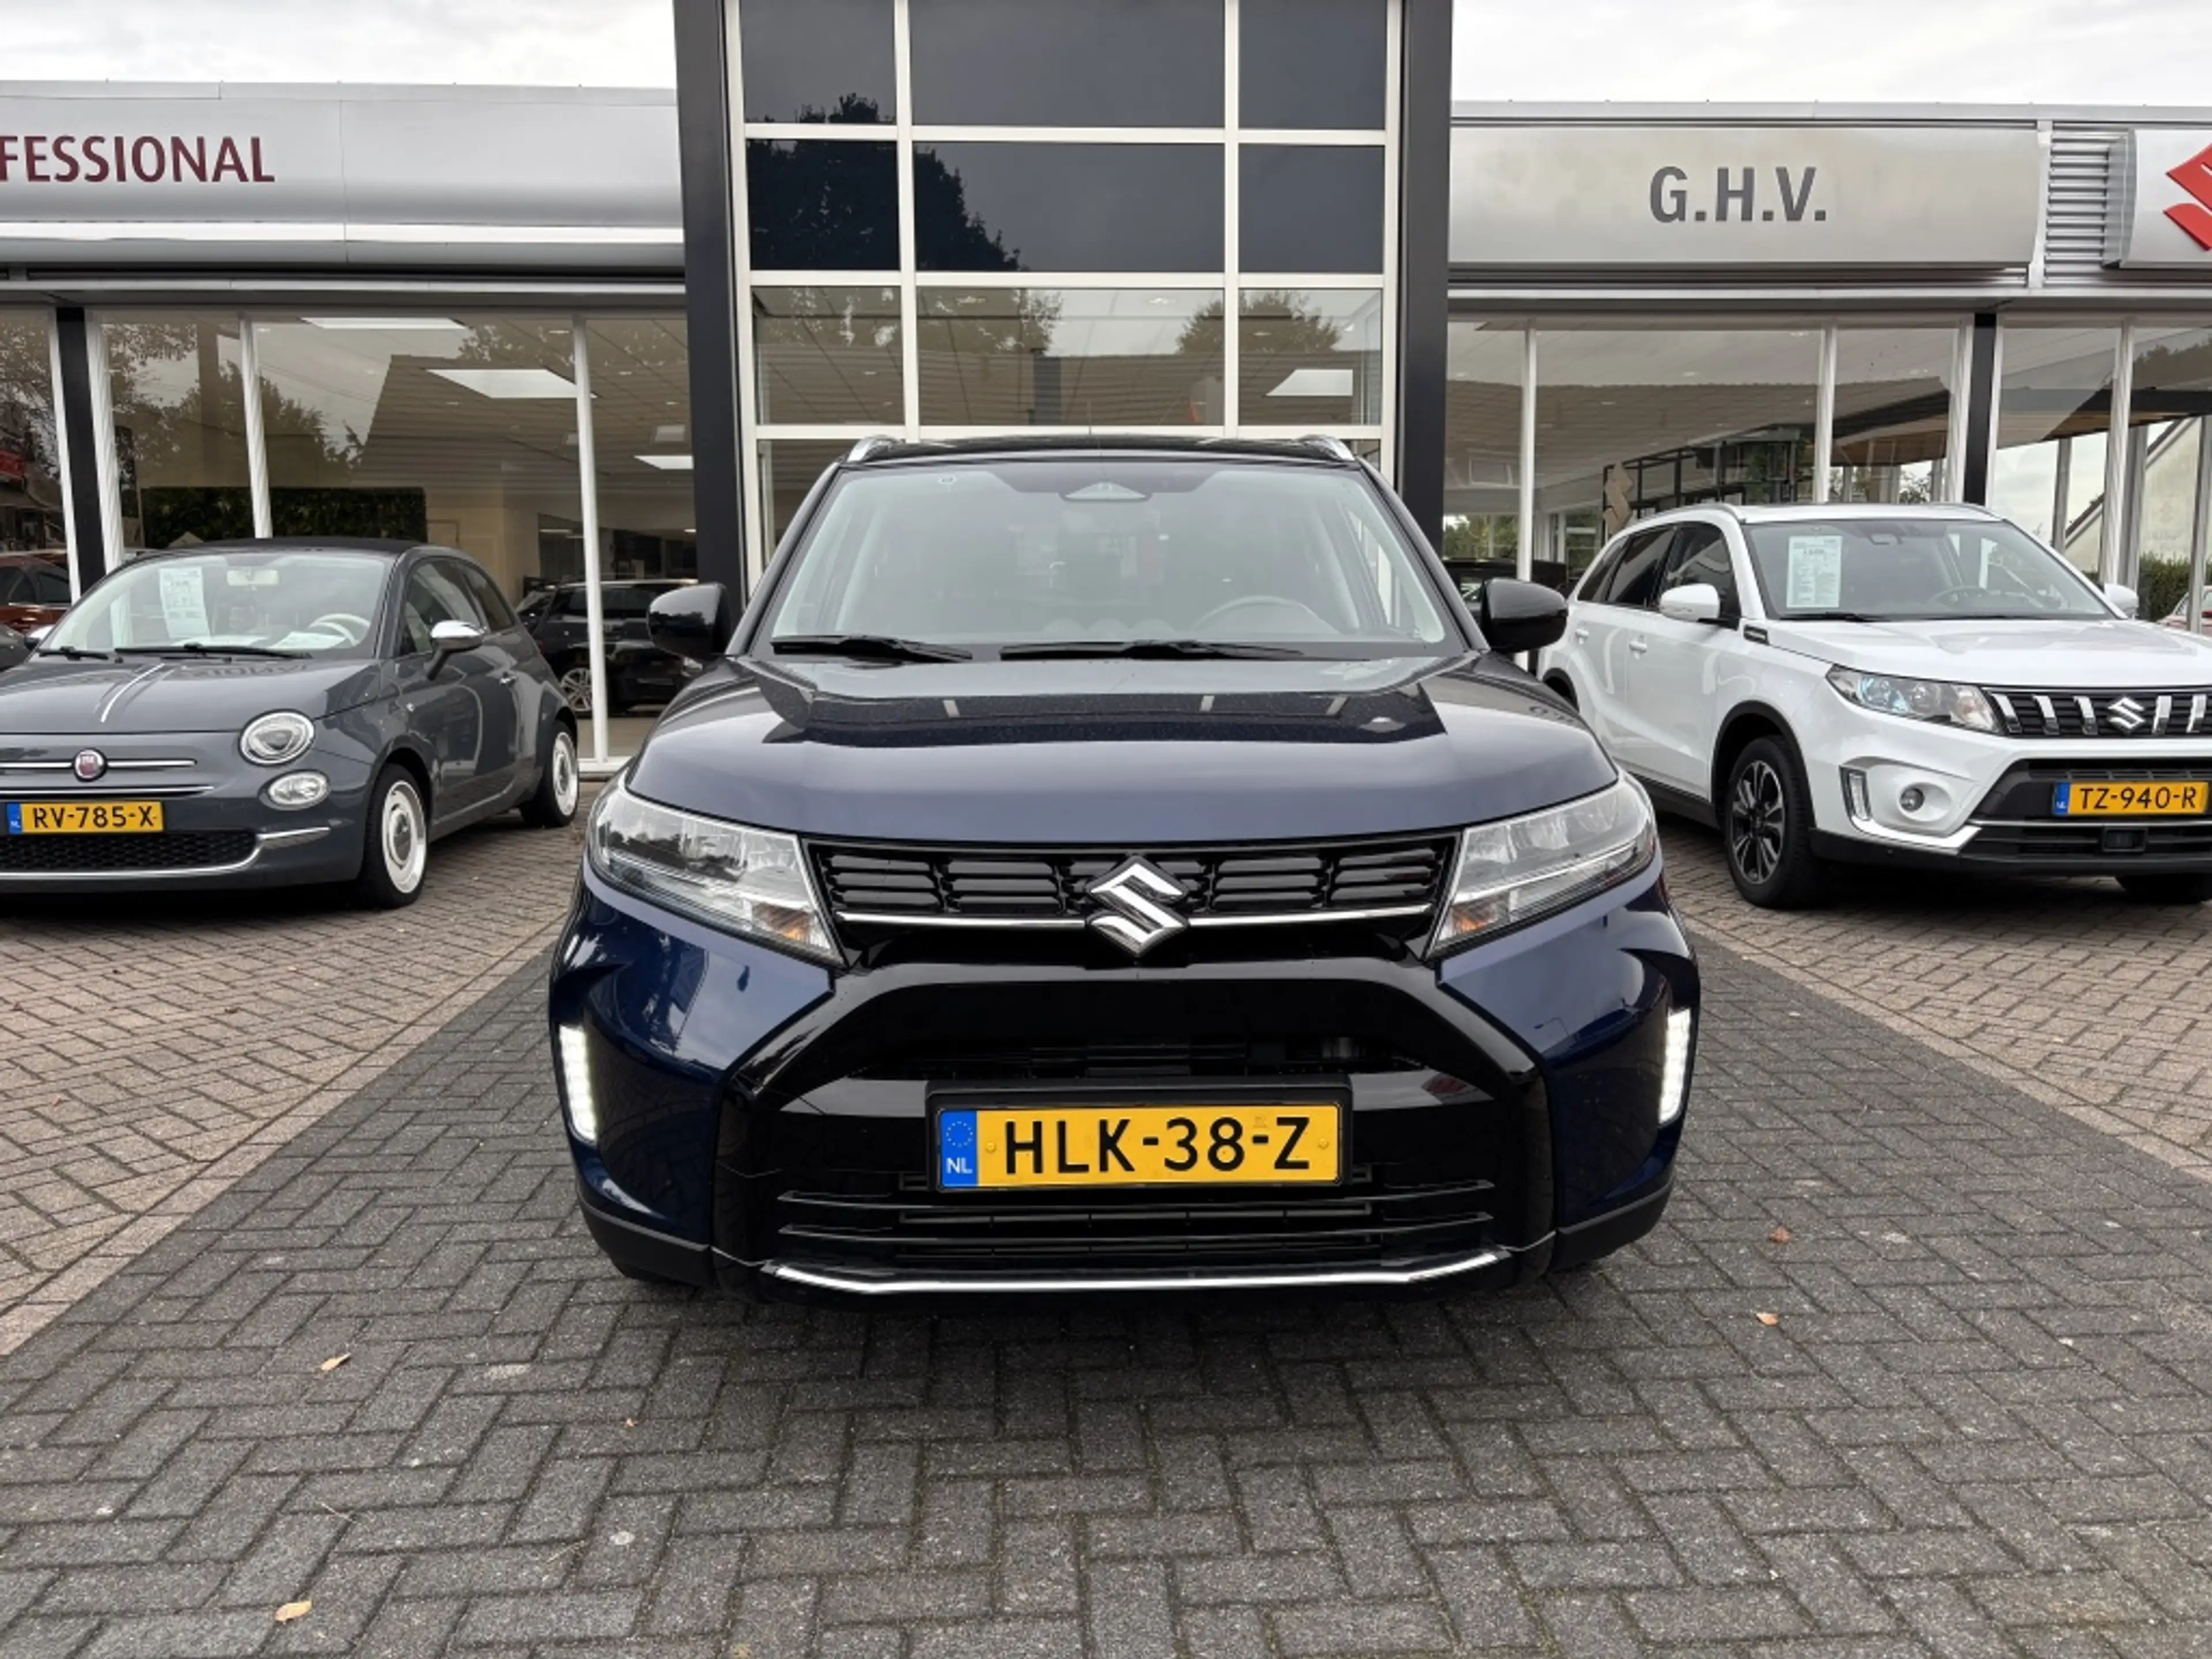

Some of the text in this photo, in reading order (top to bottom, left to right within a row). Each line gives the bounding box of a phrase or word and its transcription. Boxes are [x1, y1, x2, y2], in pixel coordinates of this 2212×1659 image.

[0, 135, 275, 183] FESSIONAL
[1650, 166, 1826, 222] G.H.V.
[2080, 787, 2196, 809] TZ-940-R
[33, 806, 154, 828] RV-785-X
[1006, 1117, 1309, 1174] HLK-38-Z
[946, 1157, 973, 1174] NL
